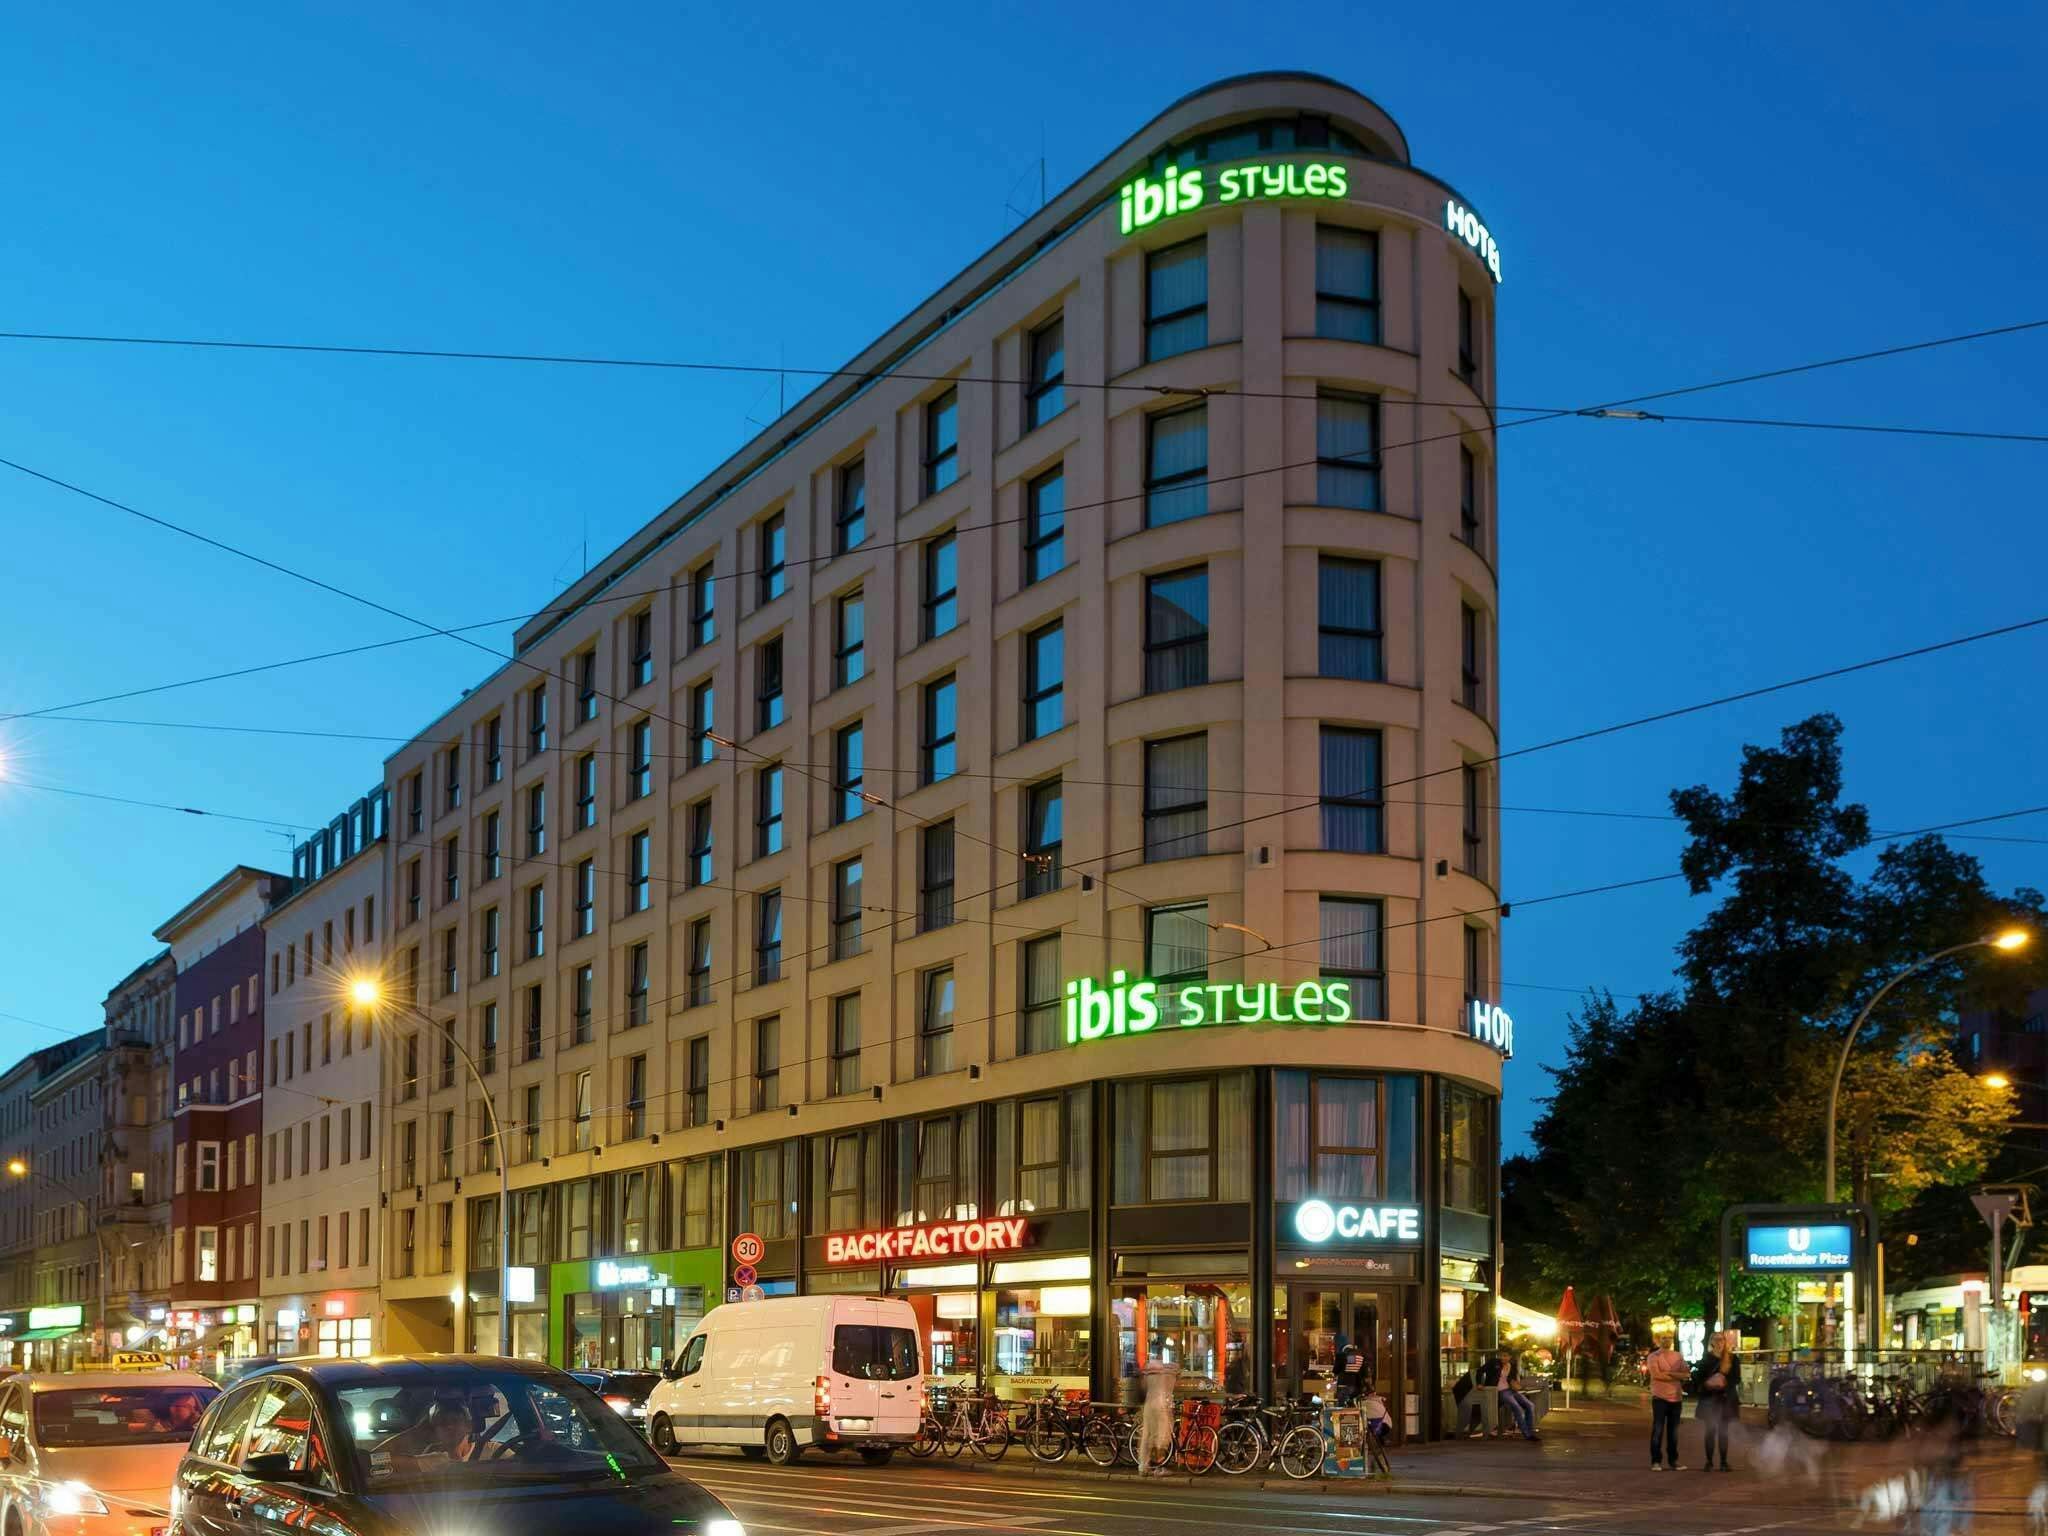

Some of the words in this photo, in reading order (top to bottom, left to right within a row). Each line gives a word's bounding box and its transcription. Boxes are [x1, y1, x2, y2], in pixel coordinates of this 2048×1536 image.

[1120, 165, 1203, 234] ibis
[1066, 970, 1158, 1043] ibis
[1337, 1206, 1419, 1239] CAFE
[740, 1241, 757, 1255] 30
[1788, 1228, 1811, 1251] U
[1819, 1252, 1849, 1265] Platz
[121, 1353, 157, 1362] TAXI
